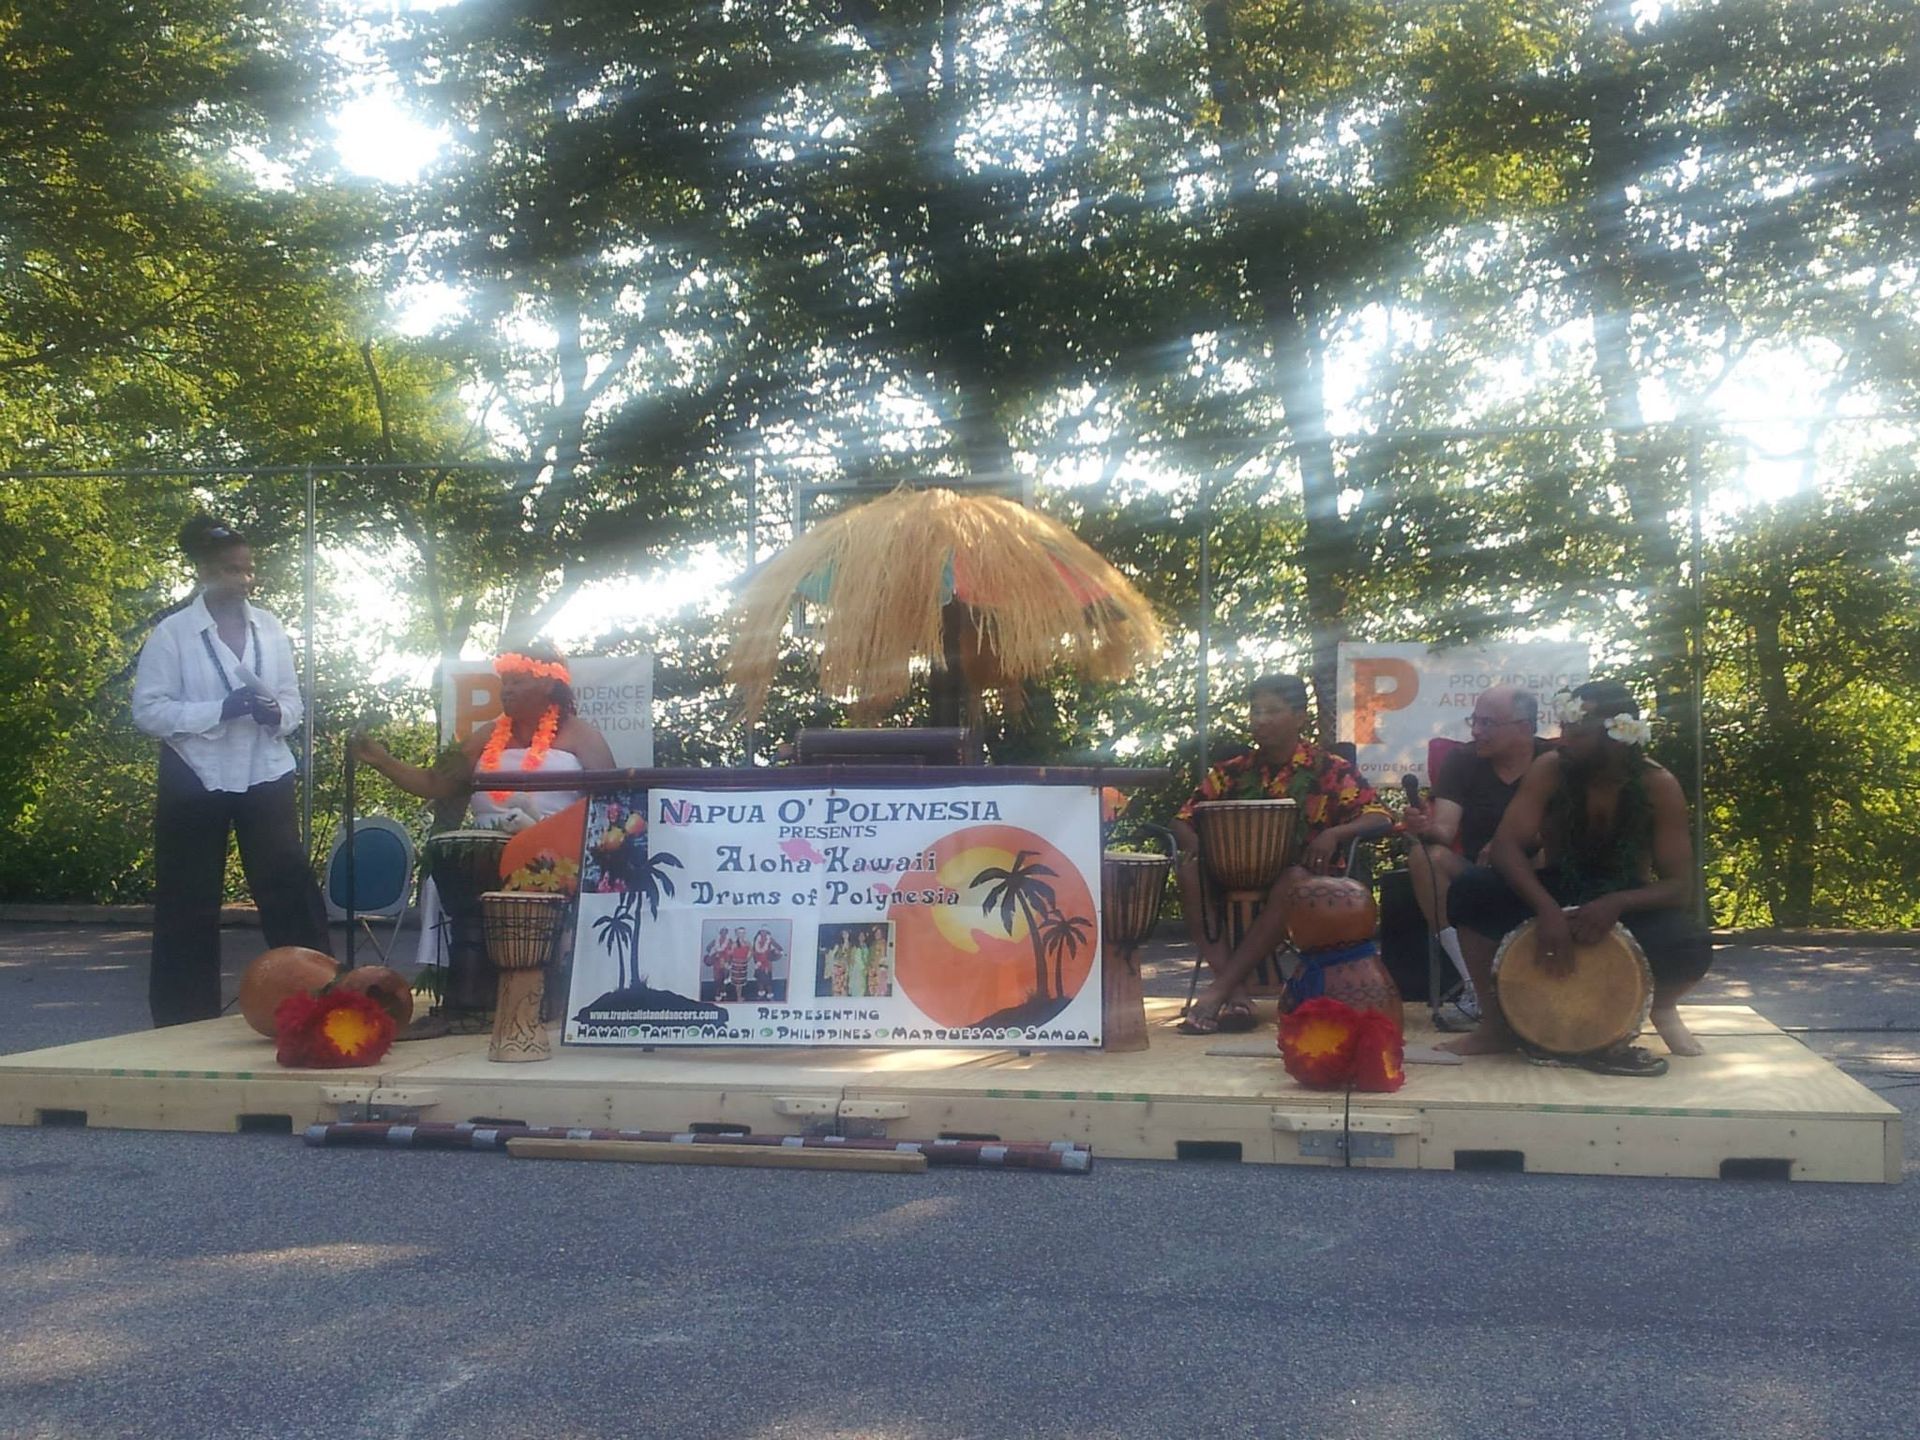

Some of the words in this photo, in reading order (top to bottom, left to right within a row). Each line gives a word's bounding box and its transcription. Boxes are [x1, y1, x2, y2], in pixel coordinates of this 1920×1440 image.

[577, 685, 646, 700] IDENCE
[1345, 657, 1420, 744] P
[578, 701, 628, 716] ARKS
[1361, 762, 1425, 772] OVIDENCE
[659, 798, 765, 824] NAPUA
[778, 798, 813, 824] O'
[824, 797, 1003, 824] POLYNESIA
[778, 825, 877, 839] PRESENTS
[716, 845, 811, 873] Aloha
[691, 881, 781, 905] Drums
[791, 888, 818, 906] of
[826, 880, 960, 911] Polynesia
[589, 1009, 719, 1021] www.tropicalislanddancers.com
[757, 1007, 880, 1021] REPRESENTING
[577, 1026, 627, 1039] HAWAII
[640, 1026, 685, 1039] TAHITI
[701, 1026, 755, 1039] MAORI
[776, 1026, 872, 1040] PHILIPPINES
[891, 1026, 1006, 1040] MARQUESAS
[1025, 1026, 1090, 1041] SAMOA
